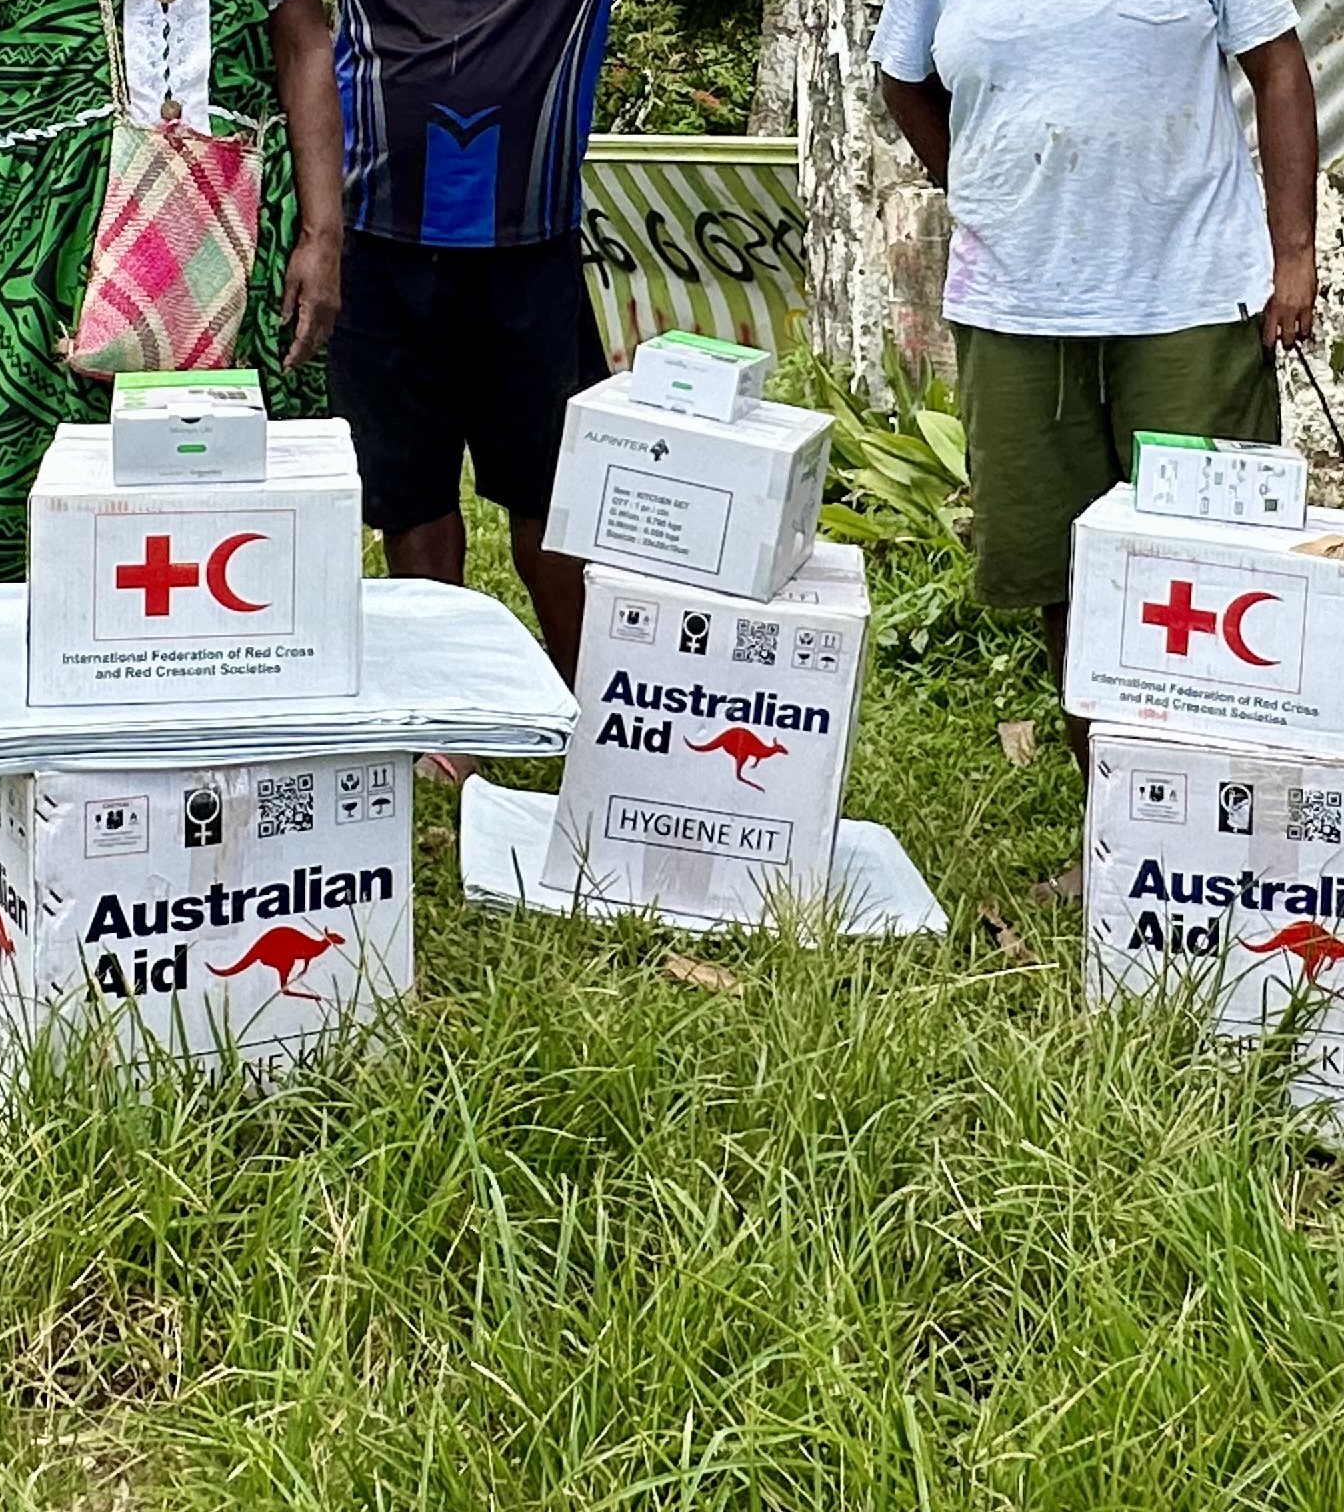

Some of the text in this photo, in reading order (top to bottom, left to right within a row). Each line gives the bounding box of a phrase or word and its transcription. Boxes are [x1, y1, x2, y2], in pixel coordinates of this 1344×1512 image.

[585, 432, 649, 453] ALPINTER
[62, 645, 314, 664] International Federation of Red Cross
[94, 663, 282, 680] and Red Crescent Societies
[601, 670, 830, 735] Australian
[1091, 671, 1320, 717] International Federation of Red Cross
[1119, 691, 1142, 704] and
[1145, 694, 1169, 709] Red
[1172, 698, 1227, 718] Crescent
[595, 712, 672, 754] Aid
[619, 808, 781, 853] HYGIENE KIT
[84, 864, 393, 944] Australian
[1128, 909, 1220, 958] Aid
[87, 944, 188, 1002] Aid
